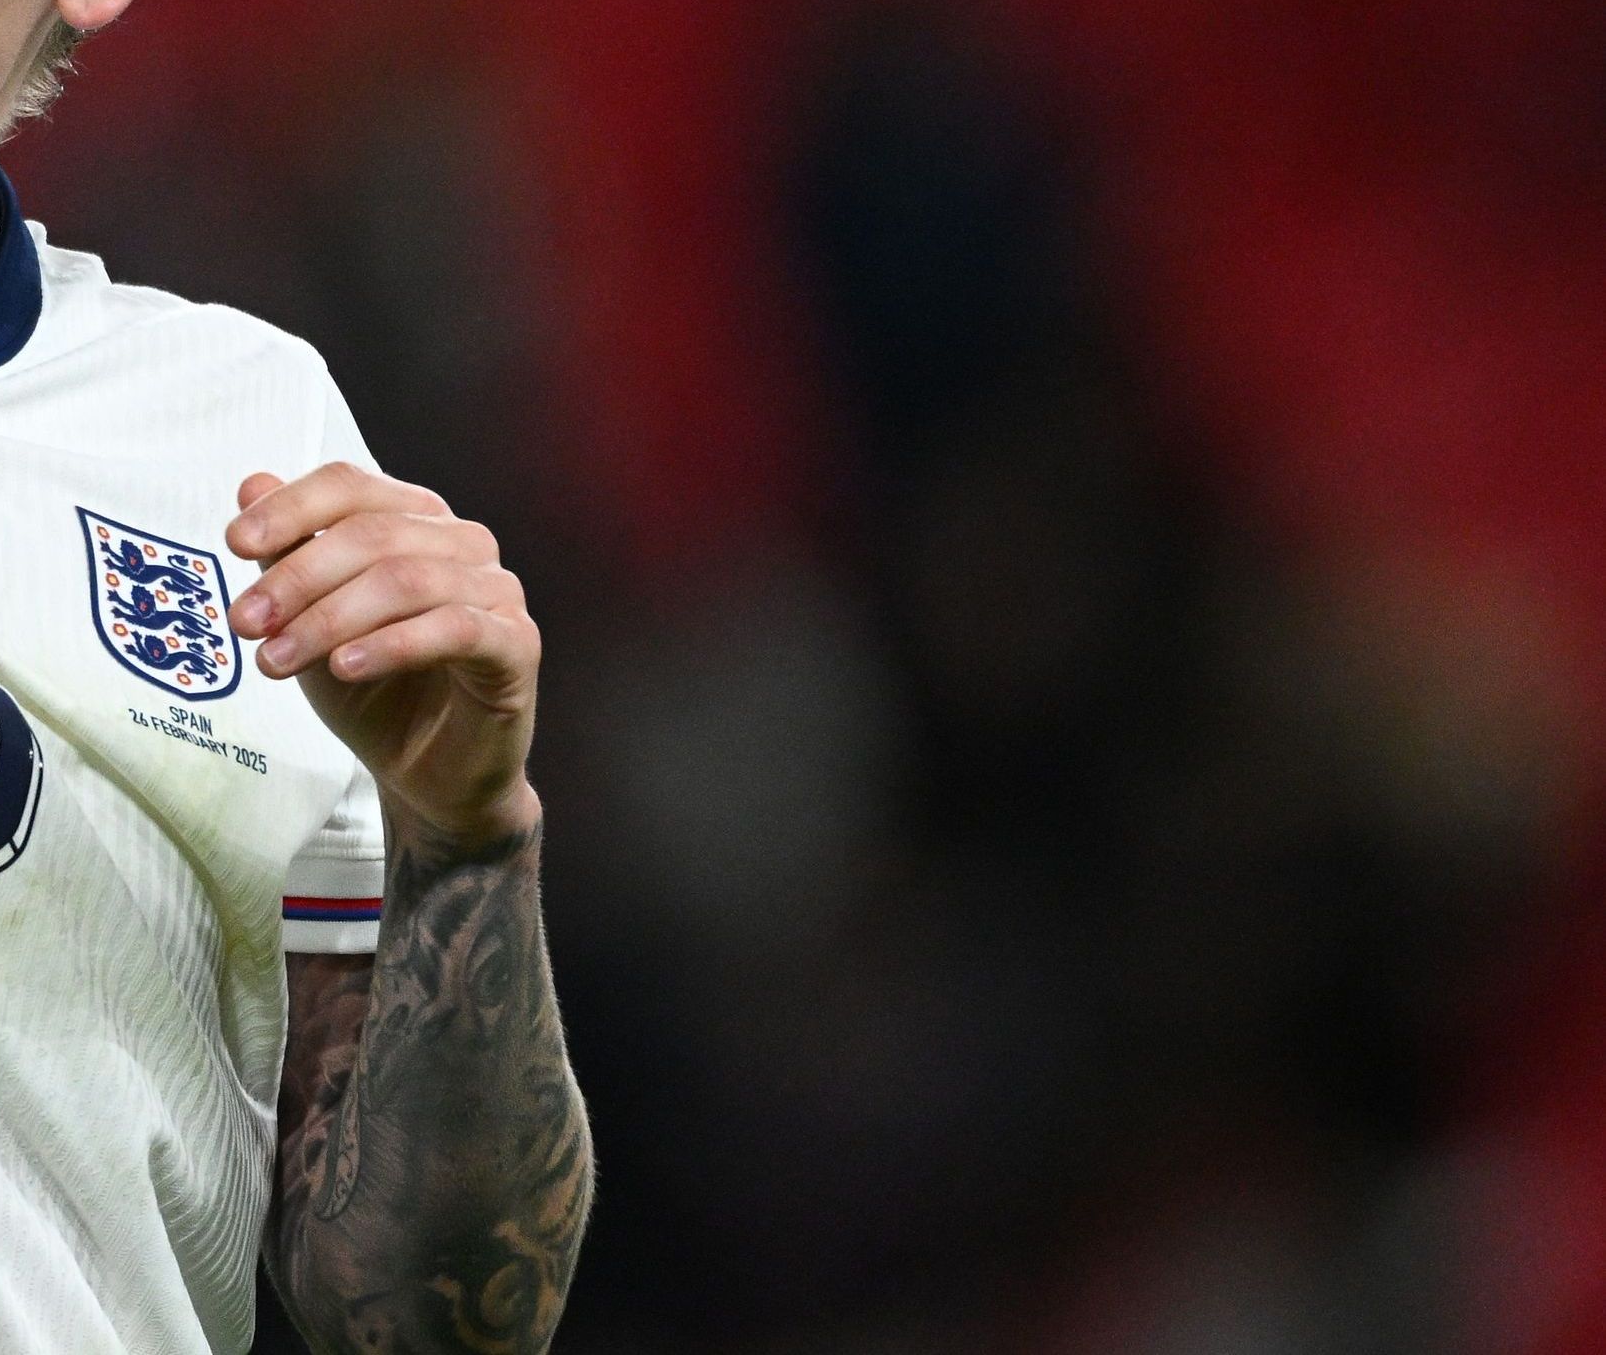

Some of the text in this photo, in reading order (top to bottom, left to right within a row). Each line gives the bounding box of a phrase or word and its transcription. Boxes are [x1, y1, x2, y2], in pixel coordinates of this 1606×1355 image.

[128, 708, 268, 775] 26 FEBRUARY 2025
[169, 706, 213, 736] SPAIN
